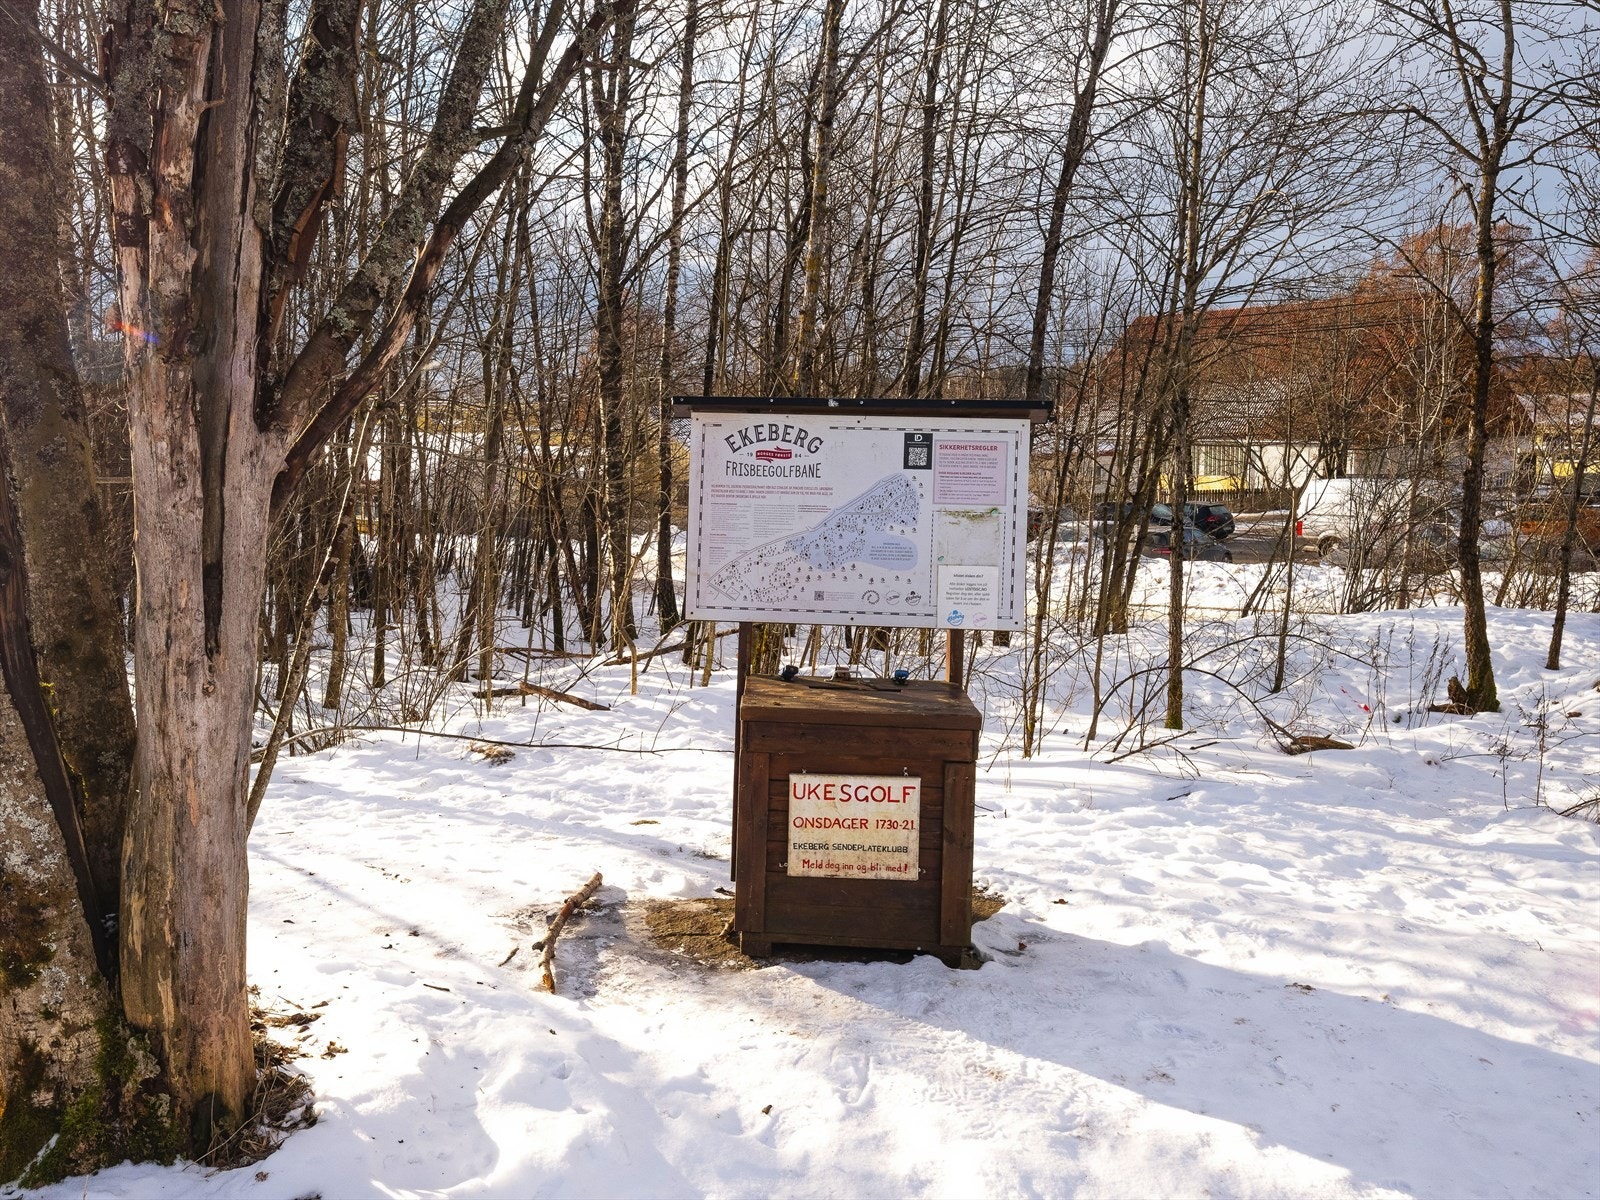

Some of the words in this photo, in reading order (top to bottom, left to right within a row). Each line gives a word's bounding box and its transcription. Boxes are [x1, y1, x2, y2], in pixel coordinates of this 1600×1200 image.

[724, 423, 824, 454] EKEBERG
[725, 460, 822, 478] FRISBEEGOLFBANE
[793, 782, 917, 803] UKESGOLF
[793, 817, 869, 830] ONSDAGER
[792, 842, 830, 851] EKEBERG
[831, 843, 908, 853] SENDEPLATEKLUBB
[802, 859, 824, 869] Meld
[824, 859, 840, 872] deg
[842, 862, 854, 871] inn
[856, 863, 867, 874] og
